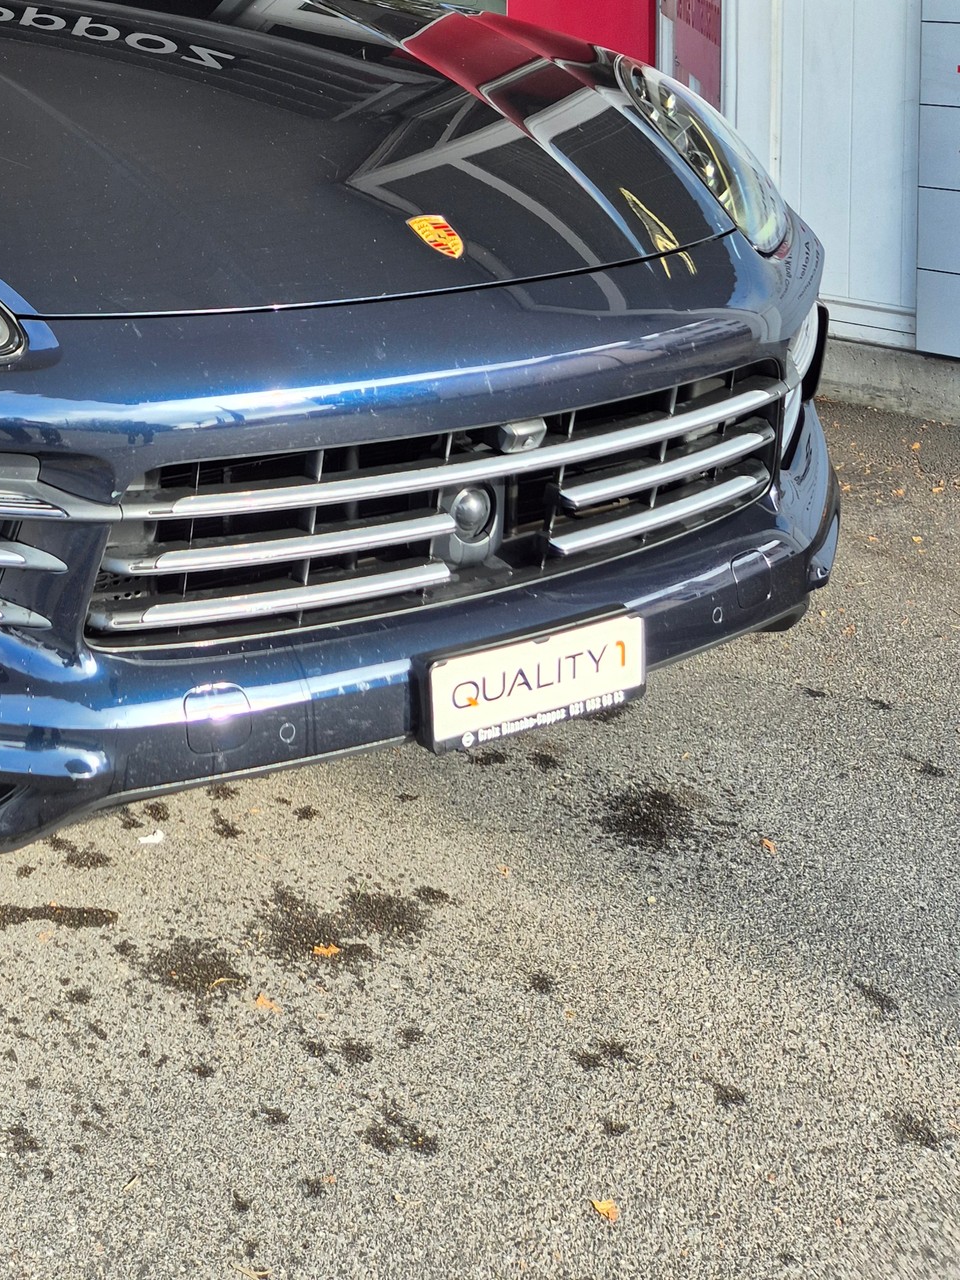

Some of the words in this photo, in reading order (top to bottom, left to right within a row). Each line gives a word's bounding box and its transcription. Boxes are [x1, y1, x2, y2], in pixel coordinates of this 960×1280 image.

[451, 644, 609, 710] QUALITY
[615, 640, 626, 667] 1
[477, 726, 501, 743] Croix
